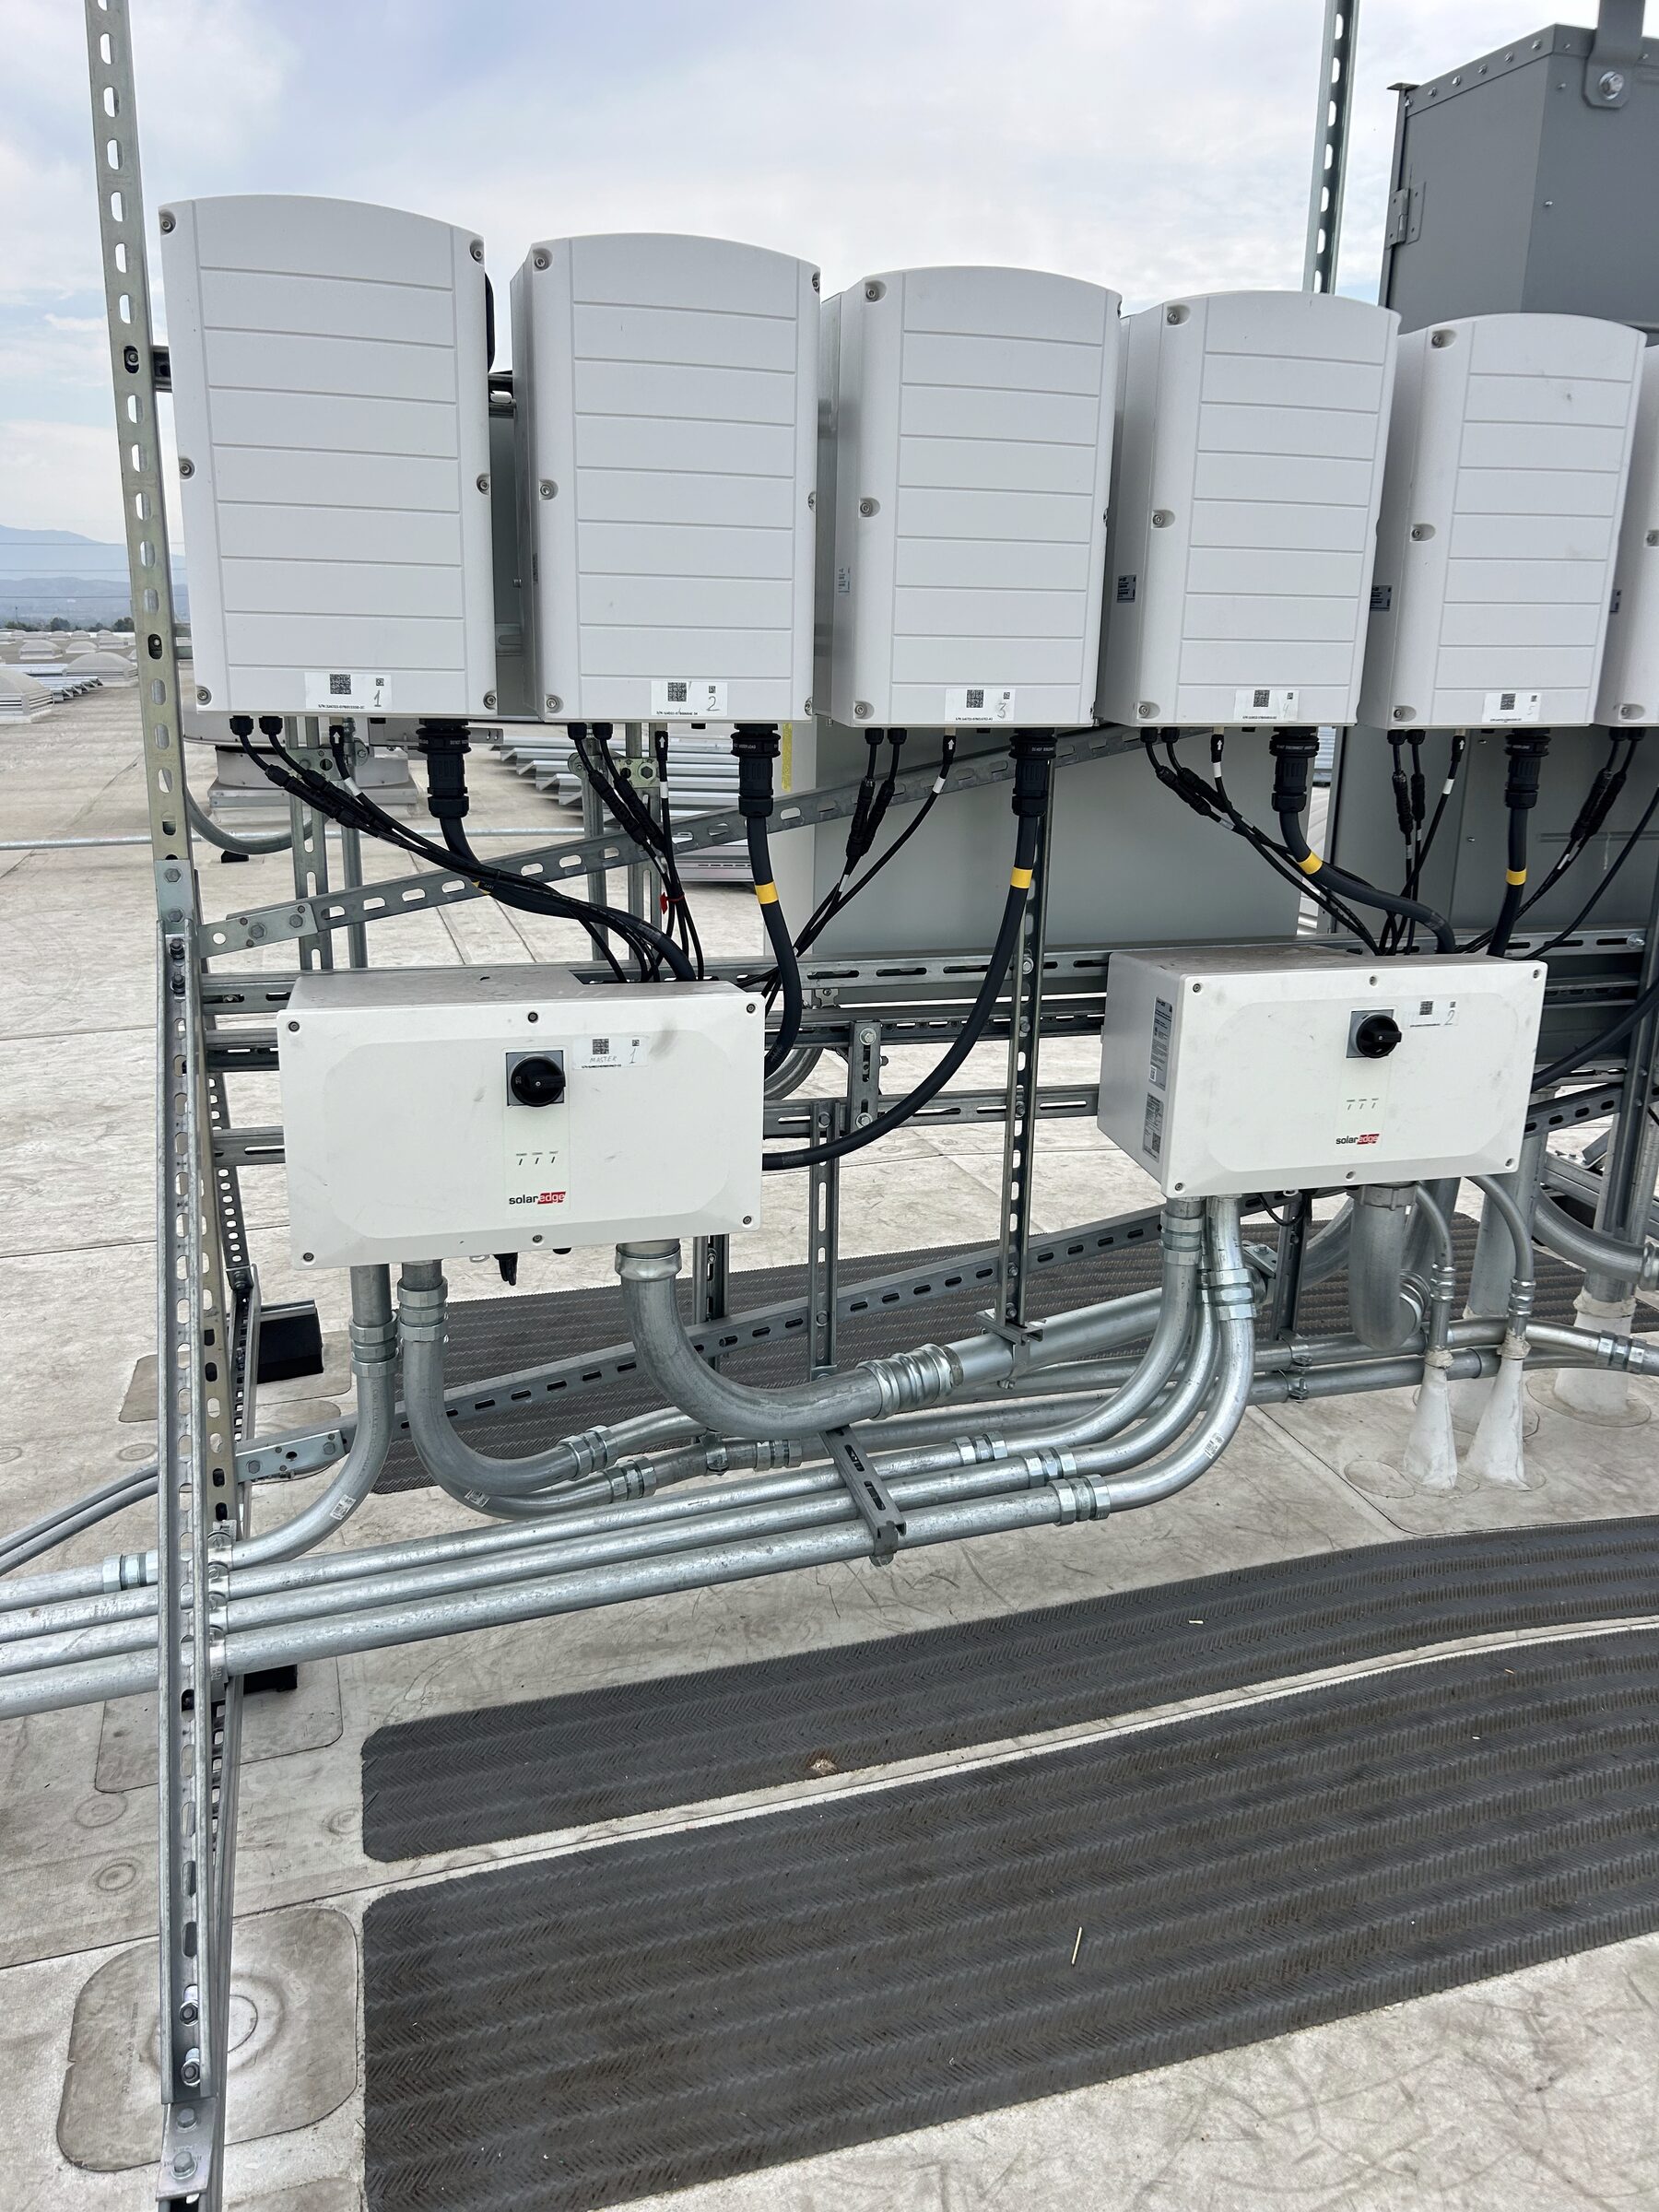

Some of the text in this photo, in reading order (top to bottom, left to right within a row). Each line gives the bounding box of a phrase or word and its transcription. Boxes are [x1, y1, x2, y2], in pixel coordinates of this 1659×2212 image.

[373, 689, 382, 707] 1
[706, 696, 720, 712] 2
[996, 702, 1006, 719] 3
[1444, 1009, 1455, 1026] 2
[589, 1055, 618, 1064] MASTER
[629, 1048, 637, 1065] 1
[1335, 1134, 1380, 1145] solaredge
[509, 1192, 566, 1205] solaredge
